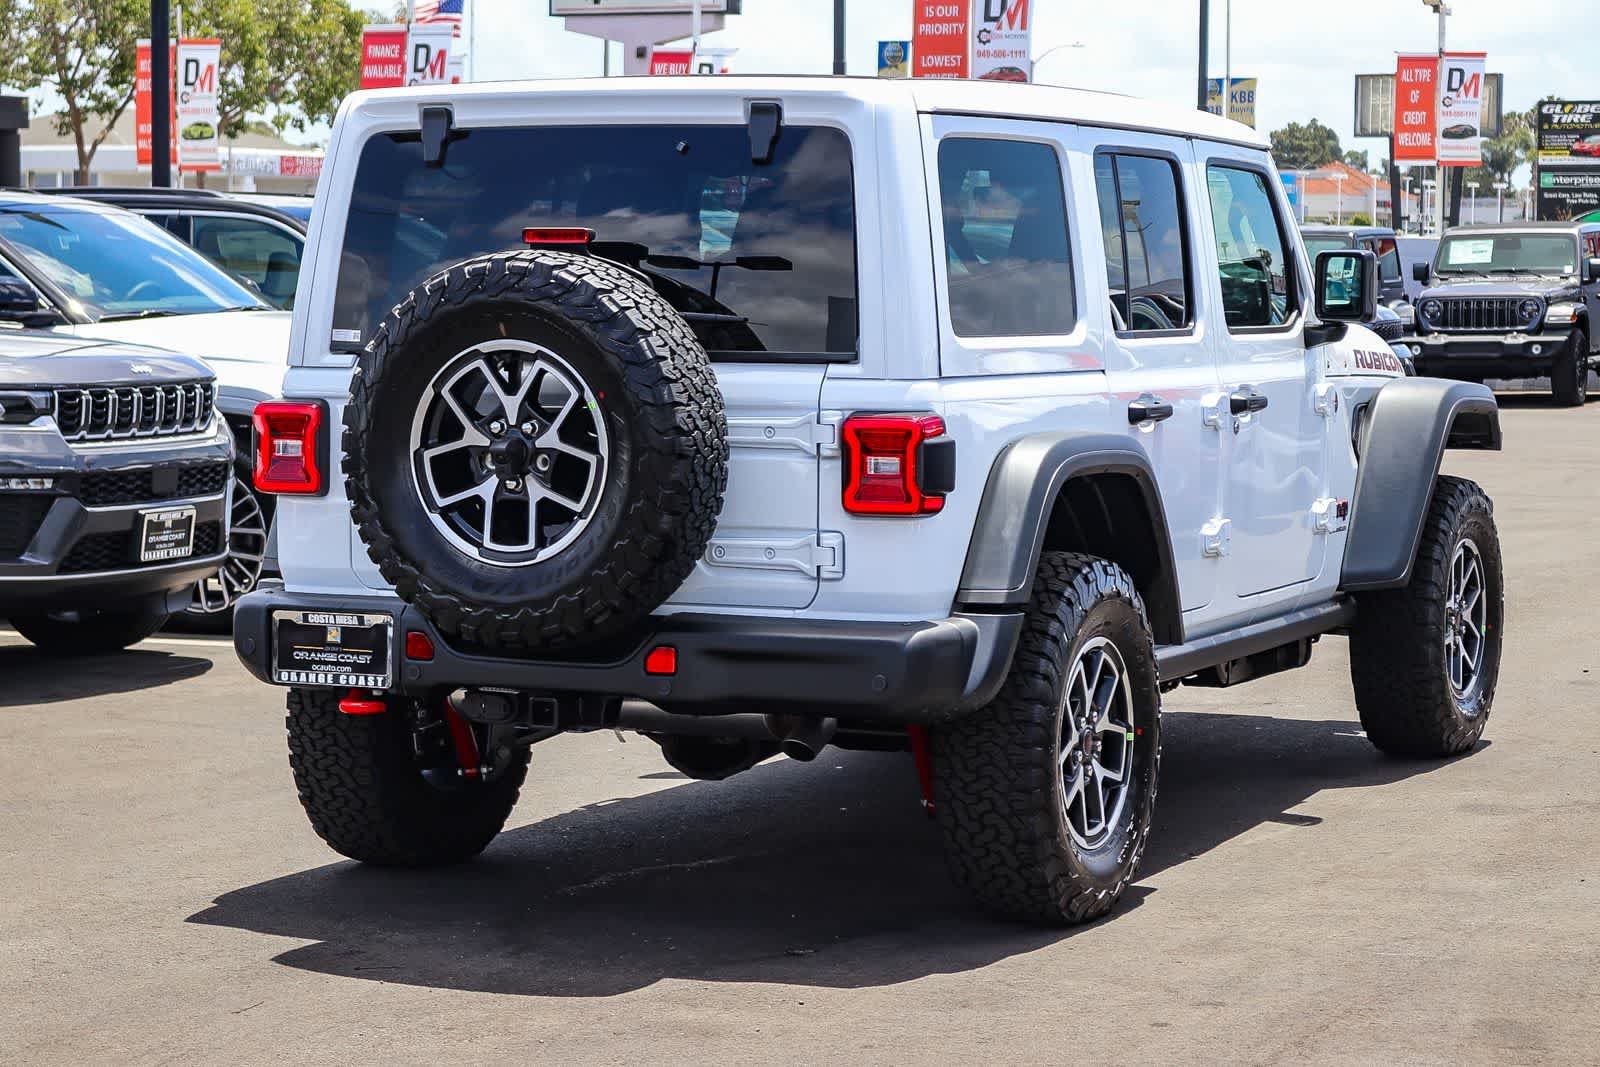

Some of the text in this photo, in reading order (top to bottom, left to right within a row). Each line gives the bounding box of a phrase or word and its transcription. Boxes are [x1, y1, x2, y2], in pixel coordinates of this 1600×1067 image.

[925, 6, 959, 17] IS OUR
[919, 23, 965, 35] PRIORITY
[368, 44, 400, 58] FINANCE
[921, 55, 962, 67] LOWEST
[363, 63, 402, 79] AVAILABLE
[654, 63, 668, 74] WE
[669, 63, 687, 74] BUY
[1401, 69, 1432, 83] ALL TYPE
[1231, 90, 1255, 103] KBB
[1410, 89, 1420, 104] OF
[1403, 111, 1426, 125] CREDIT
[1552, 113, 1593, 123] TIRE
[1398, 132, 1432, 146] WELCOME
[1353, 349, 1403, 373] RUBICON
[308, 614, 358, 625] COSTA MESA
[293, 651, 373, 664] ORANGE COAST
[311, 664, 352, 673] ocauto.com
[281, 671, 385, 687] ORANGE COAST
